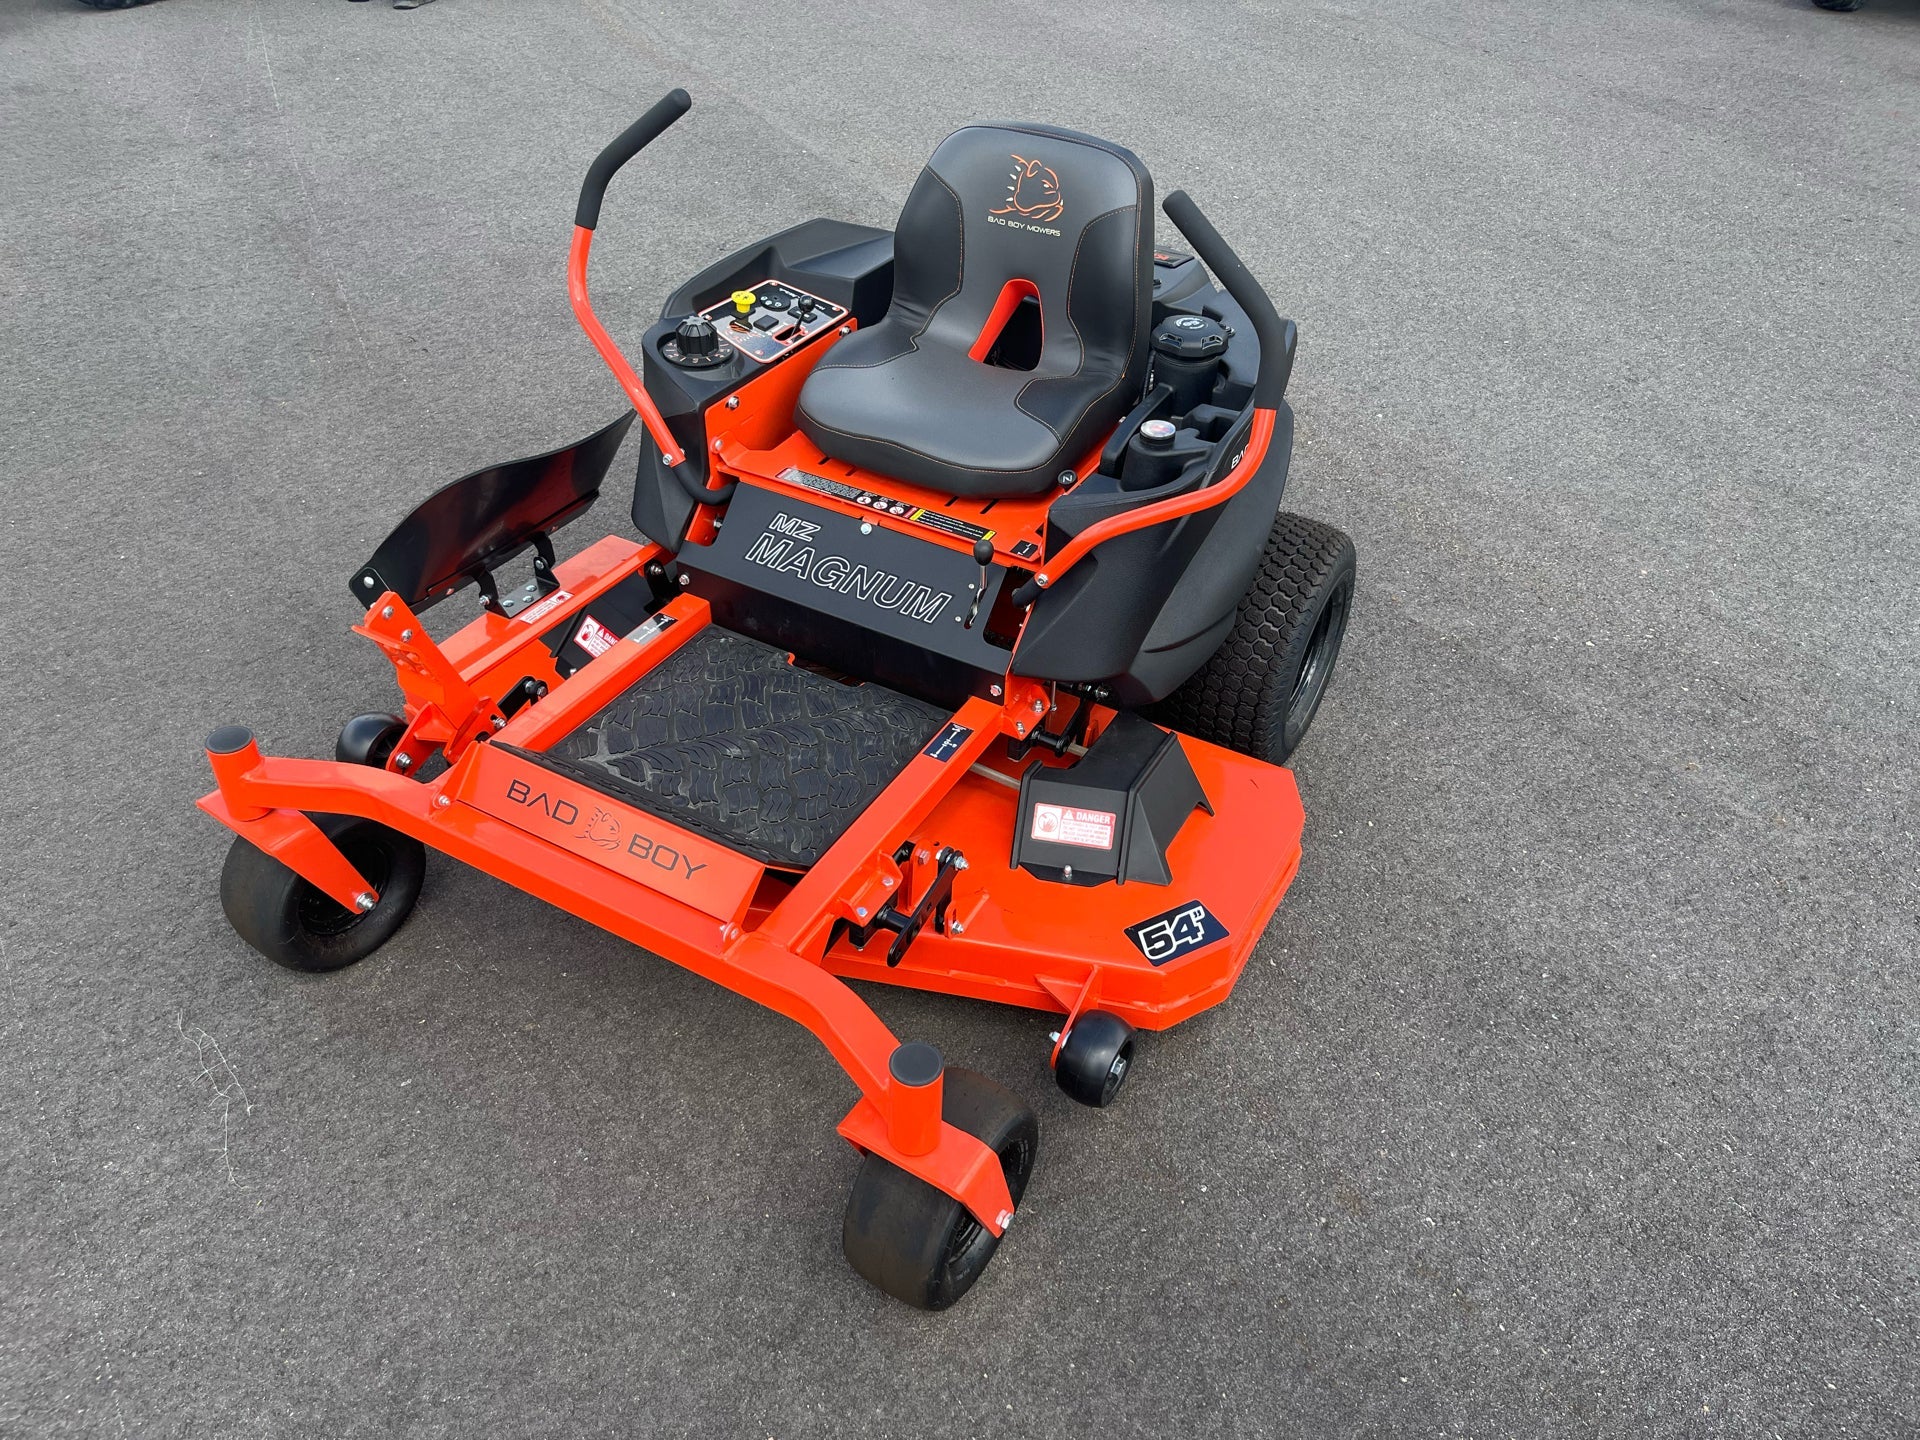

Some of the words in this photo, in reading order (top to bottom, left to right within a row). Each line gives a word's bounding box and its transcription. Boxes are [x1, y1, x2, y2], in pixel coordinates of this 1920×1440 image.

[987, 216, 1006, 225] BAD
[1008, 220, 1026, 229] BOY
[1027, 225, 1061, 236] MOWERS
[768, 513, 821, 542] MZ
[745, 533, 953, 624] MAGNUM
[506, 779, 579, 825] BAD
[627, 833, 708, 880] BOY
[1076, 811, 1111, 825] DANGER
